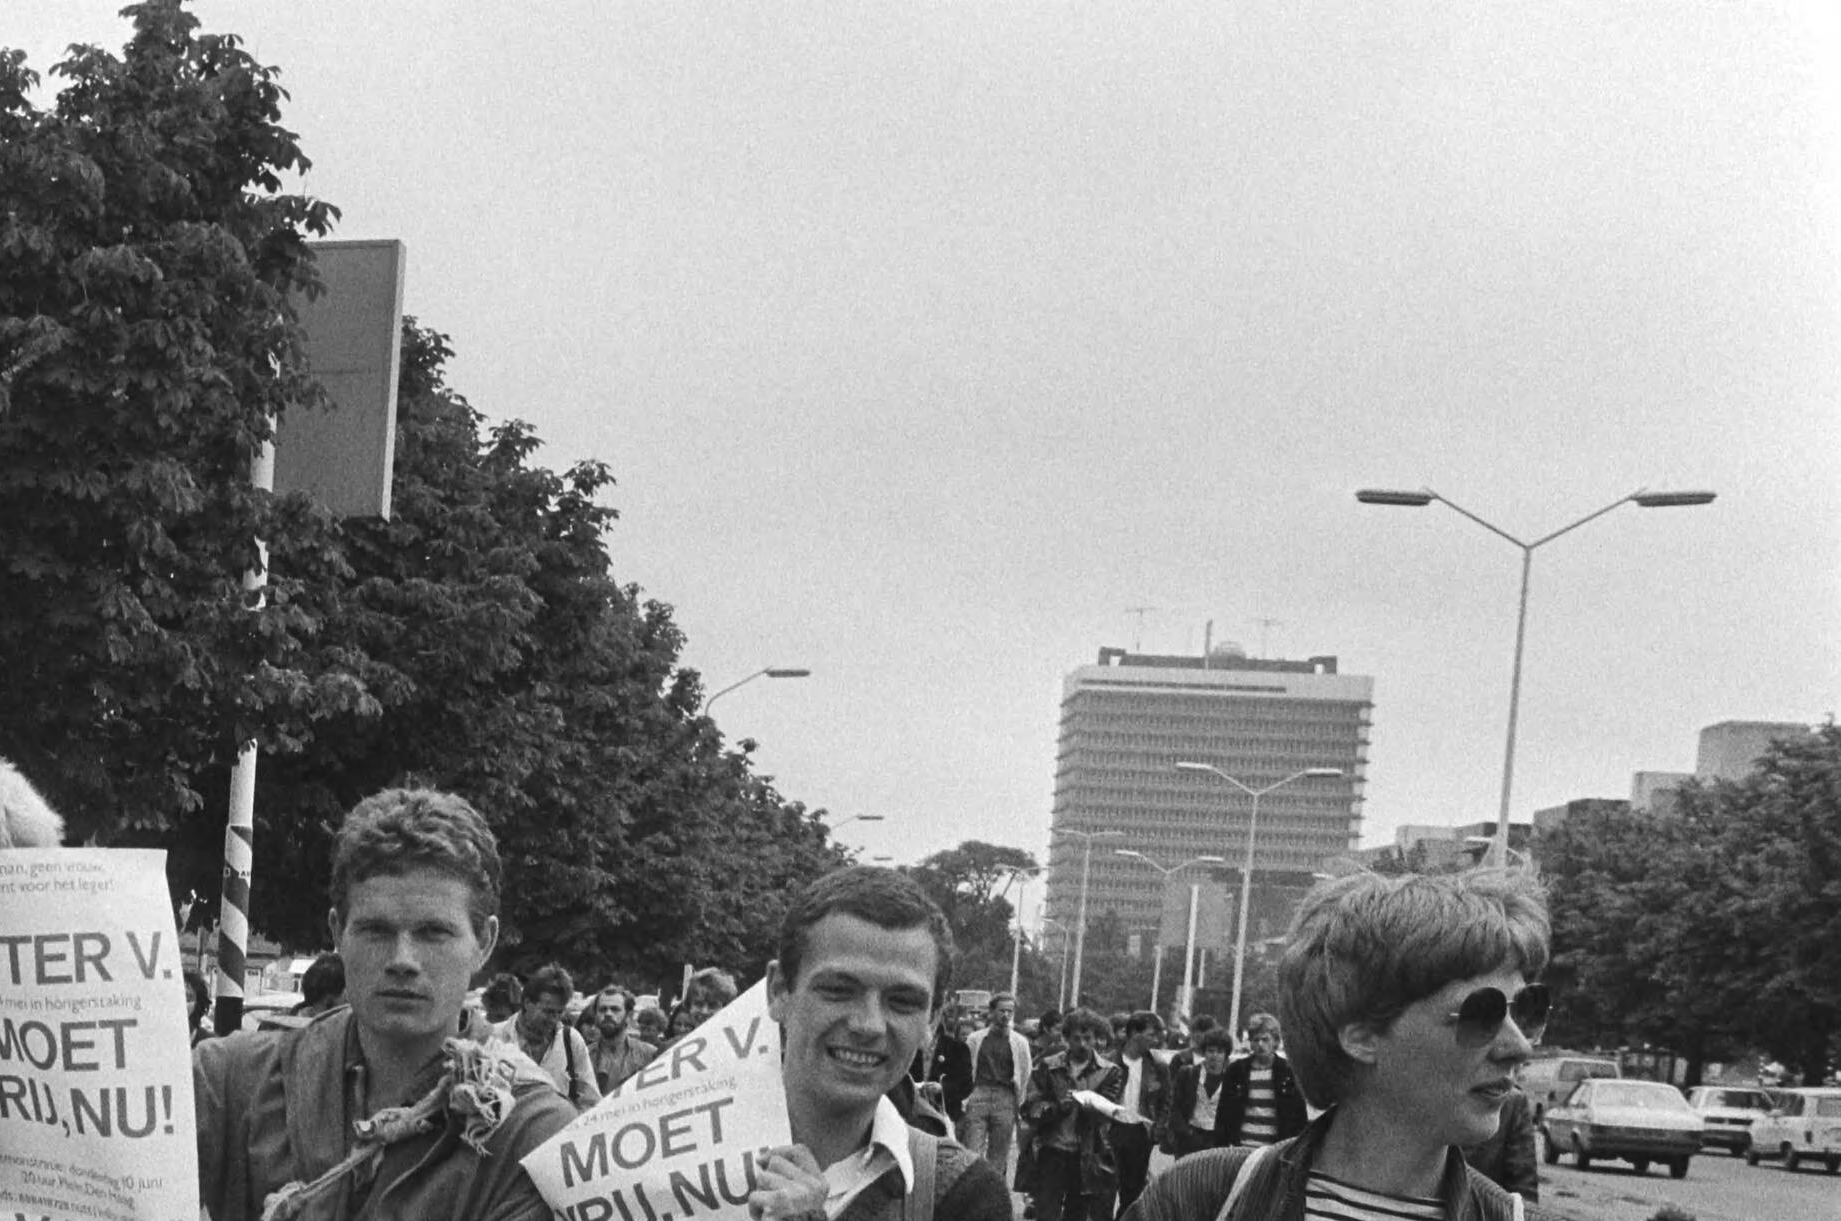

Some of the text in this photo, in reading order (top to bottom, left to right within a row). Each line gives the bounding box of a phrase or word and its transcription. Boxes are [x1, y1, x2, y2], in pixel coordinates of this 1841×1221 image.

[125, 930, 173, 981] V.
[44, 994, 142, 1015] hongerstaking
[723, 1015, 769, 1060] V.
[70, 1084, 175, 1139] NU!
[559, 1096, 734, 1190] MOET
[668, 1148, 761, 1218] NU
